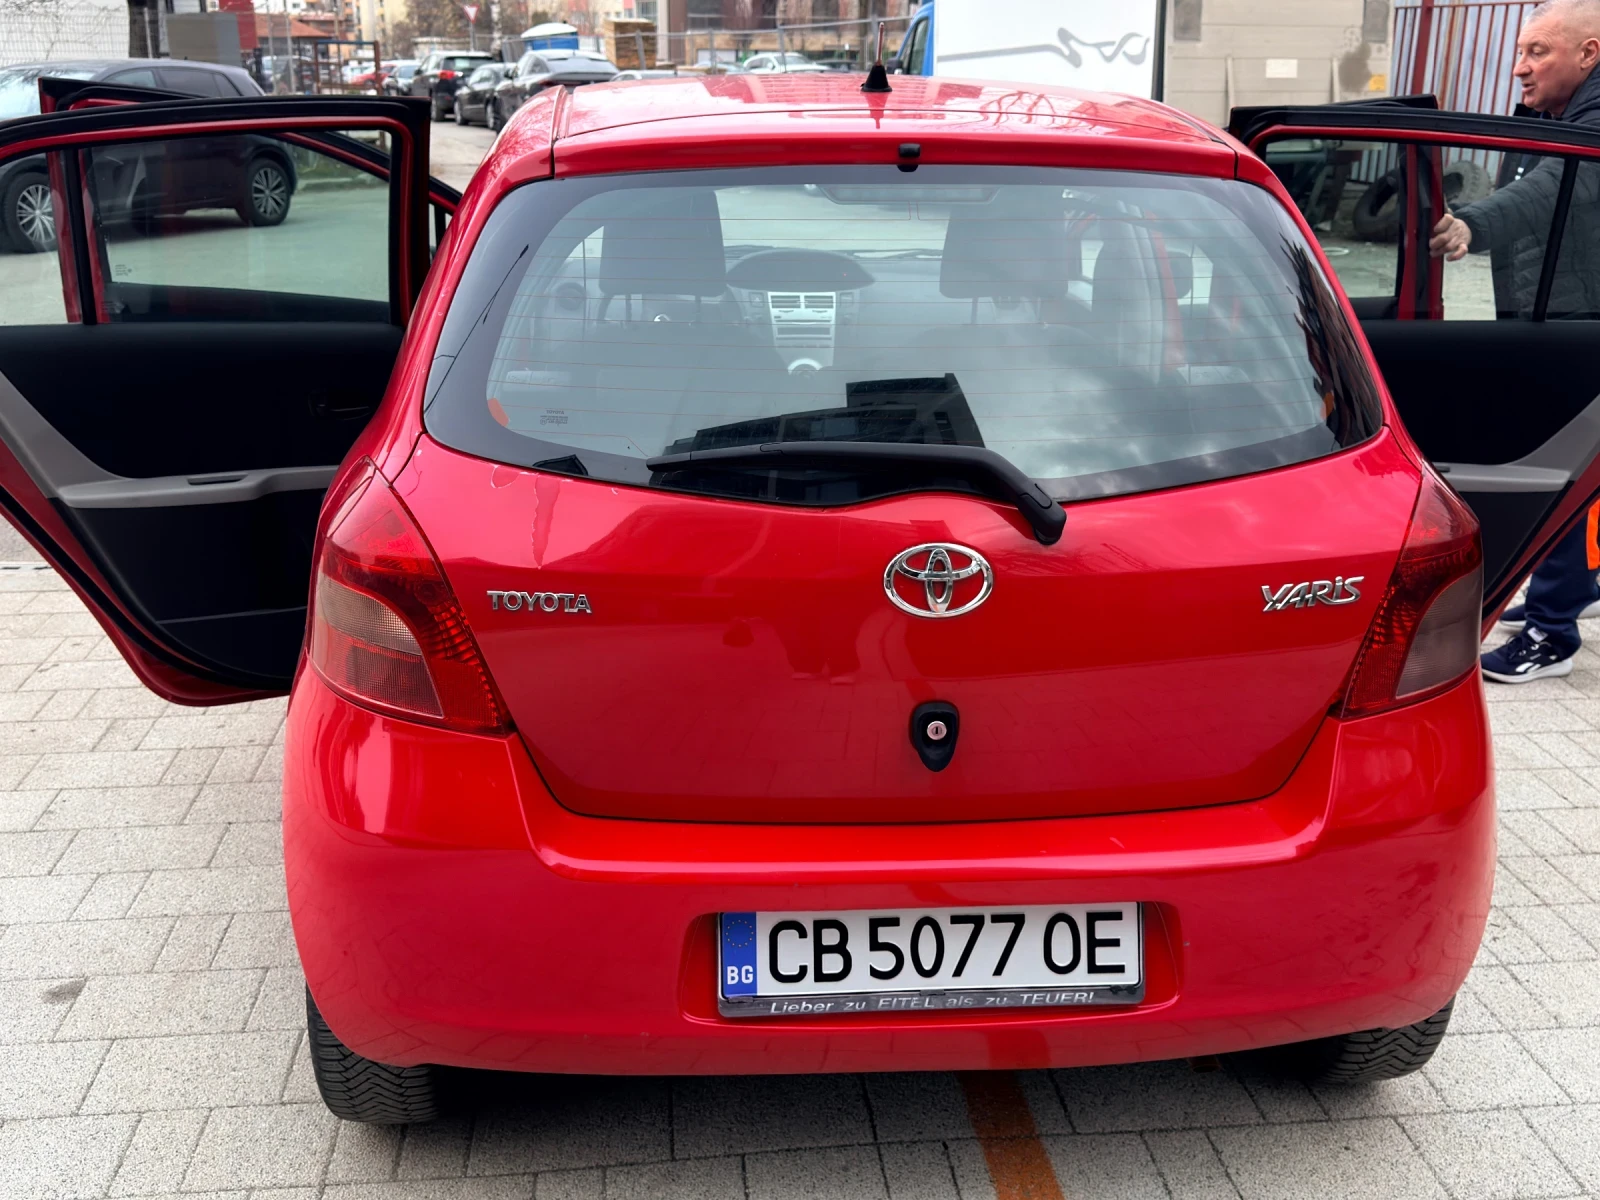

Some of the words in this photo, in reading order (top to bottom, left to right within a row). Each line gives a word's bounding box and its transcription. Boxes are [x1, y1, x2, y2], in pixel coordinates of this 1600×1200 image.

[486, 590, 592, 613] TOYOTA
[768, 919, 853, 983] CB
[868, 913, 1026, 980] 5077
[1043, 911, 1126, 976] OE
[726, 965, 754, 985] BG
[770, 1001, 834, 1014] Lieber
[843, 1001, 866, 1011] zu
[877, 996, 935, 1009] EITEL
[945, 996, 974, 1007] als
[985, 996, 1008, 1006] zu
[1019, 991, 1095, 1005] TEUER!
